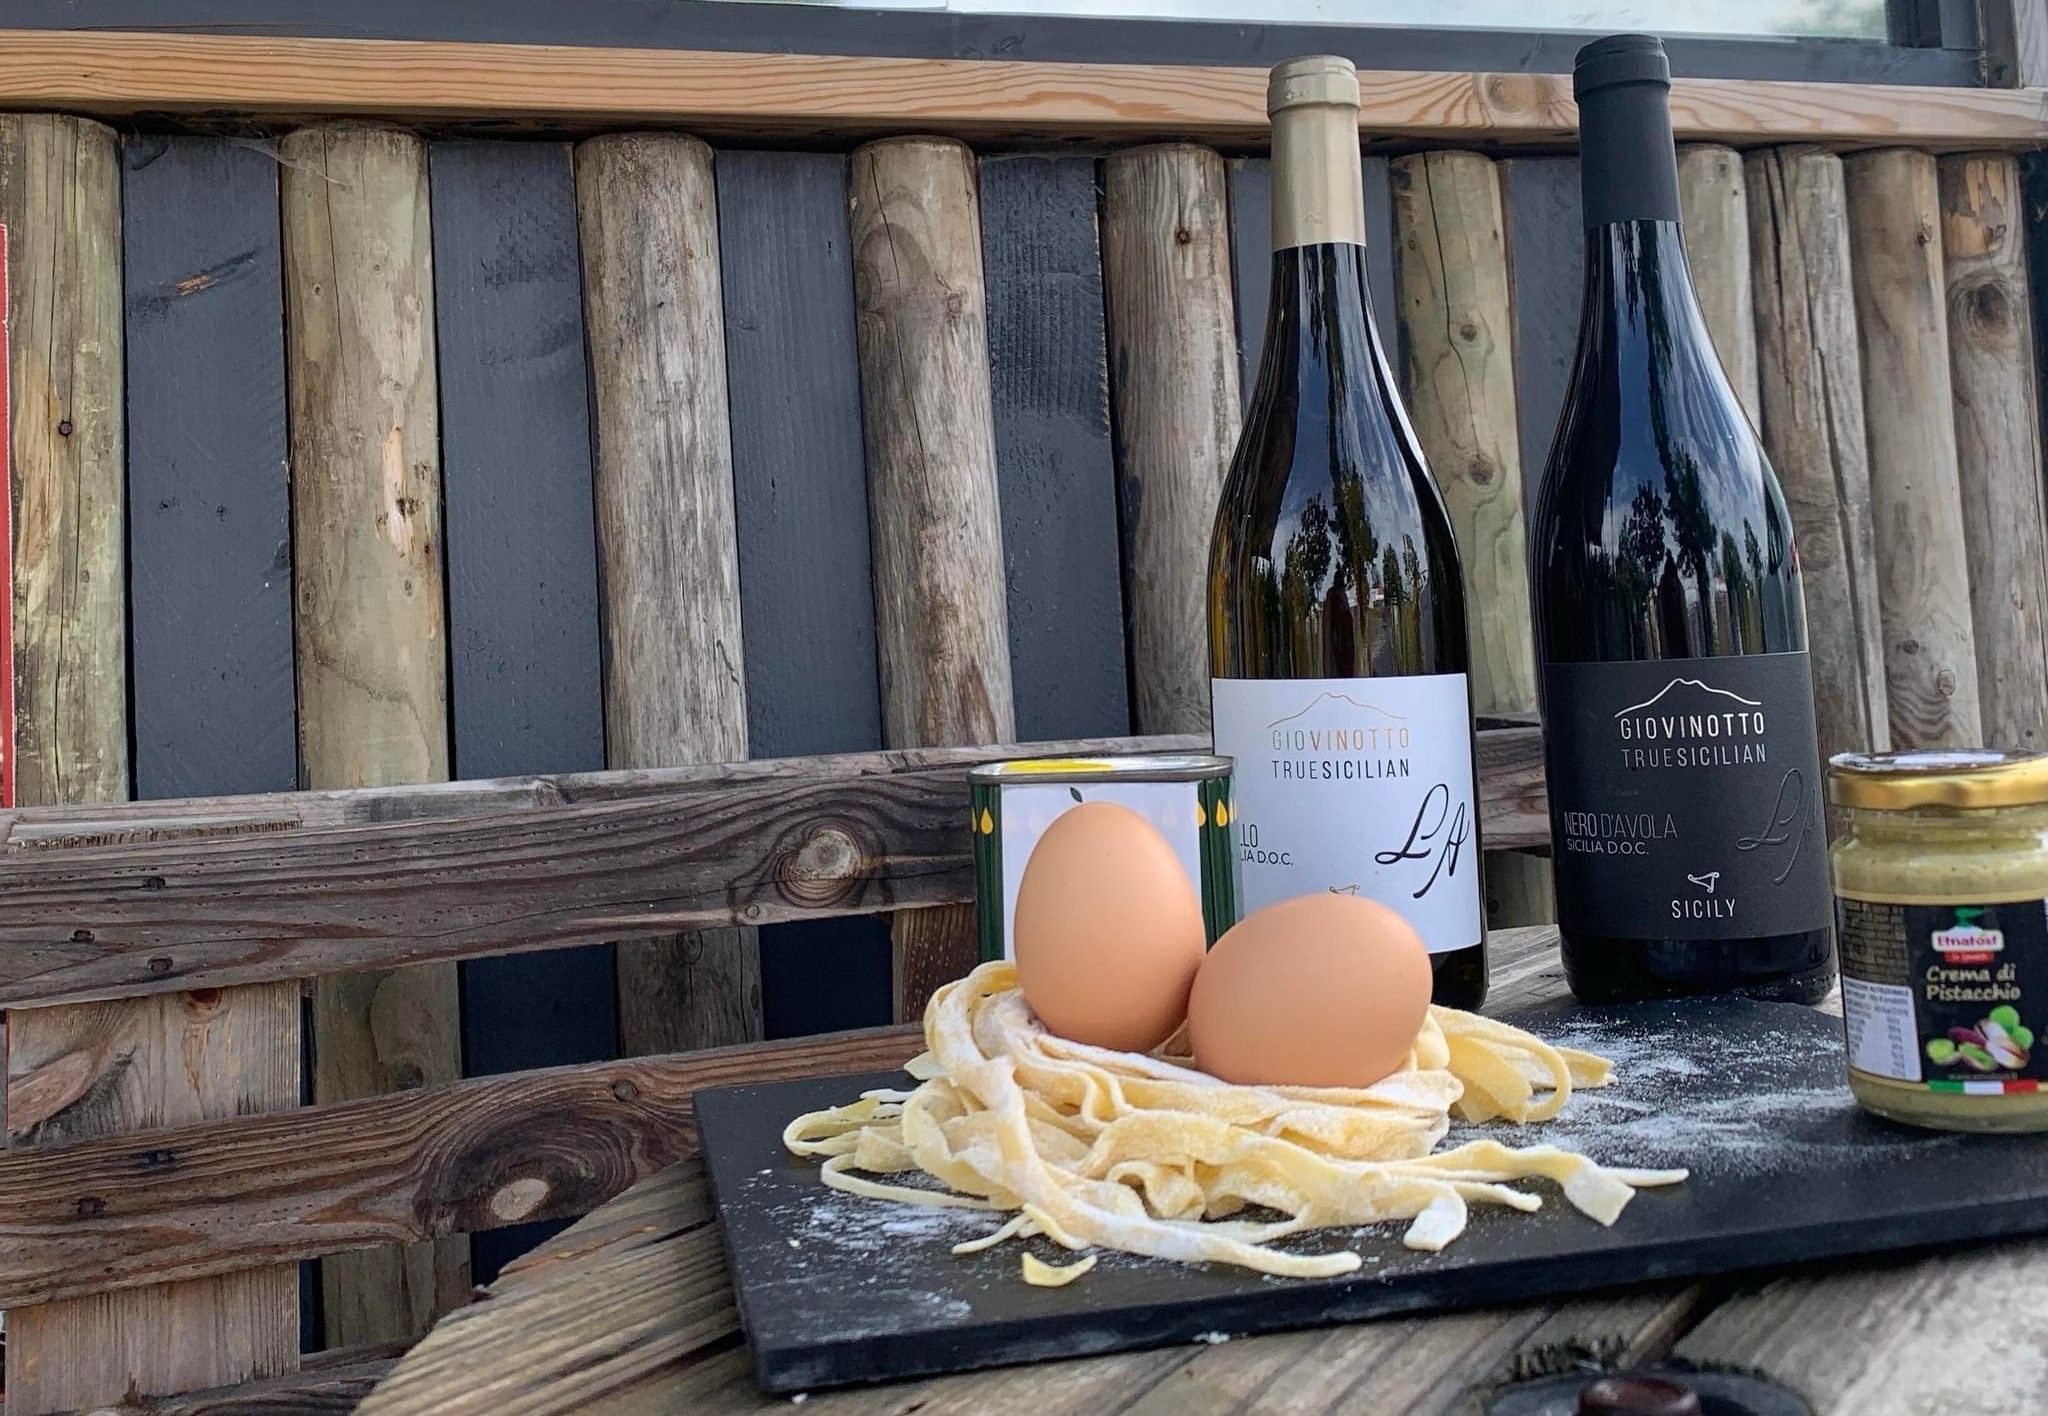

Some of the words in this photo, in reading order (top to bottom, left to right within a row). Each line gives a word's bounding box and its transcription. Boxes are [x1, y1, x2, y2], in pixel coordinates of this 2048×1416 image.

[1620, 711, 1765, 740] GIOVINOTTO
[1271, 727, 1410, 751] GIOVINOTTO
[1622, 743, 1767, 768] TRUESICILIAN
[1271, 758, 1410, 780] TRUESICILIAN
[1240, 823, 1259, 848] LO
[1564, 811, 1598, 837] NERO
[1600, 813, 1678, 839] D'AVOLA
[1240, 849, 1255, 862] IA
[1257, 850, 1294, 866] D.O.C.
[1567, 838, 1605, 854] SICILIA
[1607, 840, 1650, 856] D.O.C.
[1671, 899, 1735, 919] SICILY
[1926, 965, 1991, 982] Crema
[1996, 962, 2016, 981] di
[1926, 982, 2021, 1001] Pistacchio
